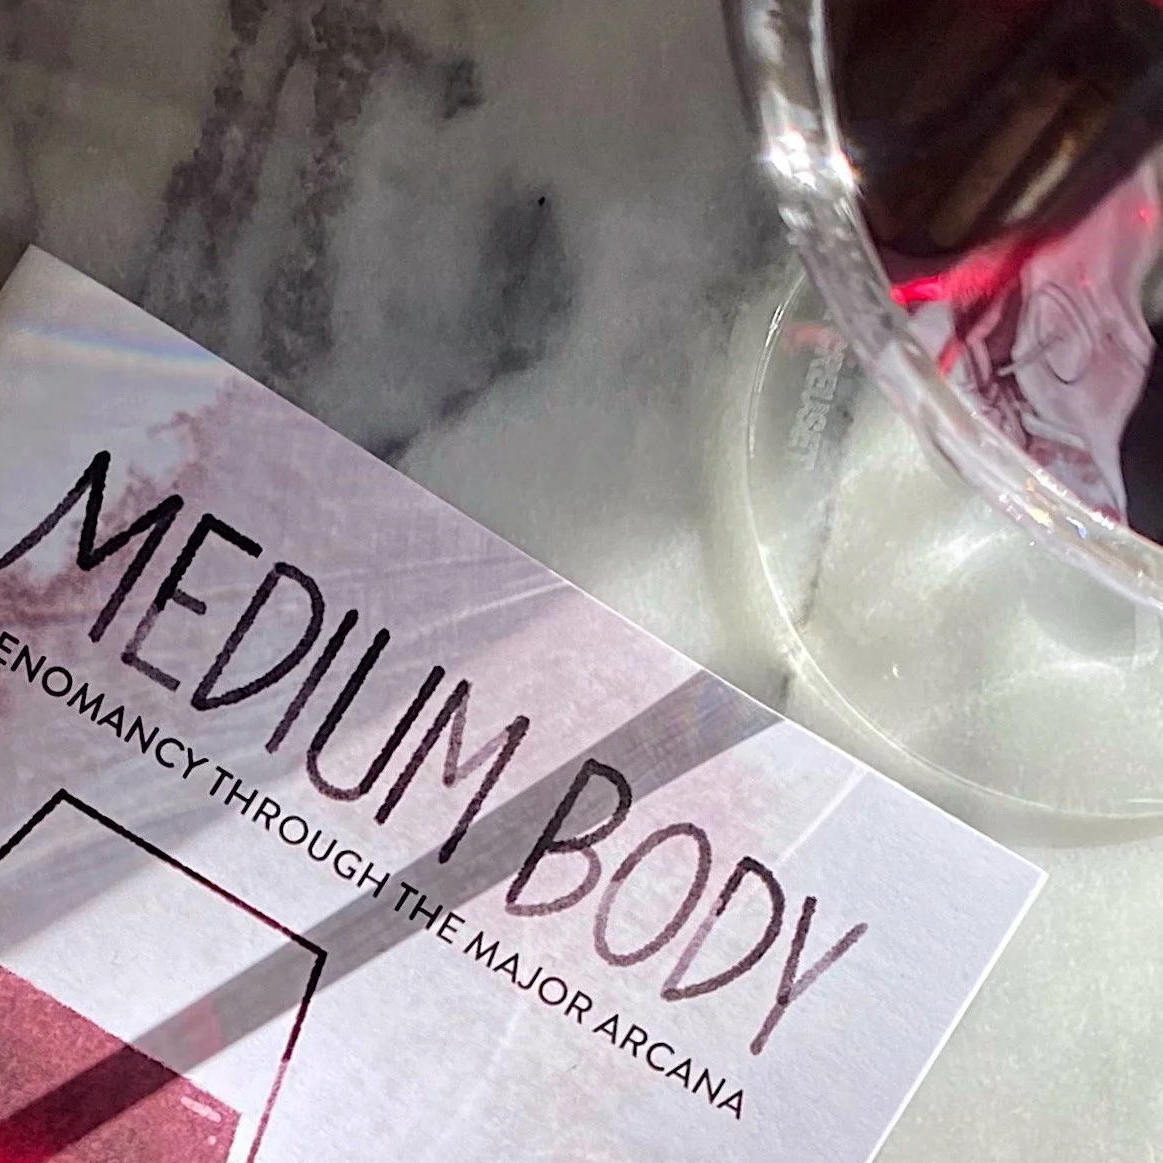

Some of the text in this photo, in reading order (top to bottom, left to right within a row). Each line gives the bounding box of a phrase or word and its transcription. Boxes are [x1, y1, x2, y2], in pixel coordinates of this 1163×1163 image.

[205, 766, 390, 898] THROUGH
[398, 881, 465, 943] THE
[464, 932, 595, 1026] MAJOR
[592, 1013, 745, 1120] ARCANA
[505, 758, 868, 1055] BODY
